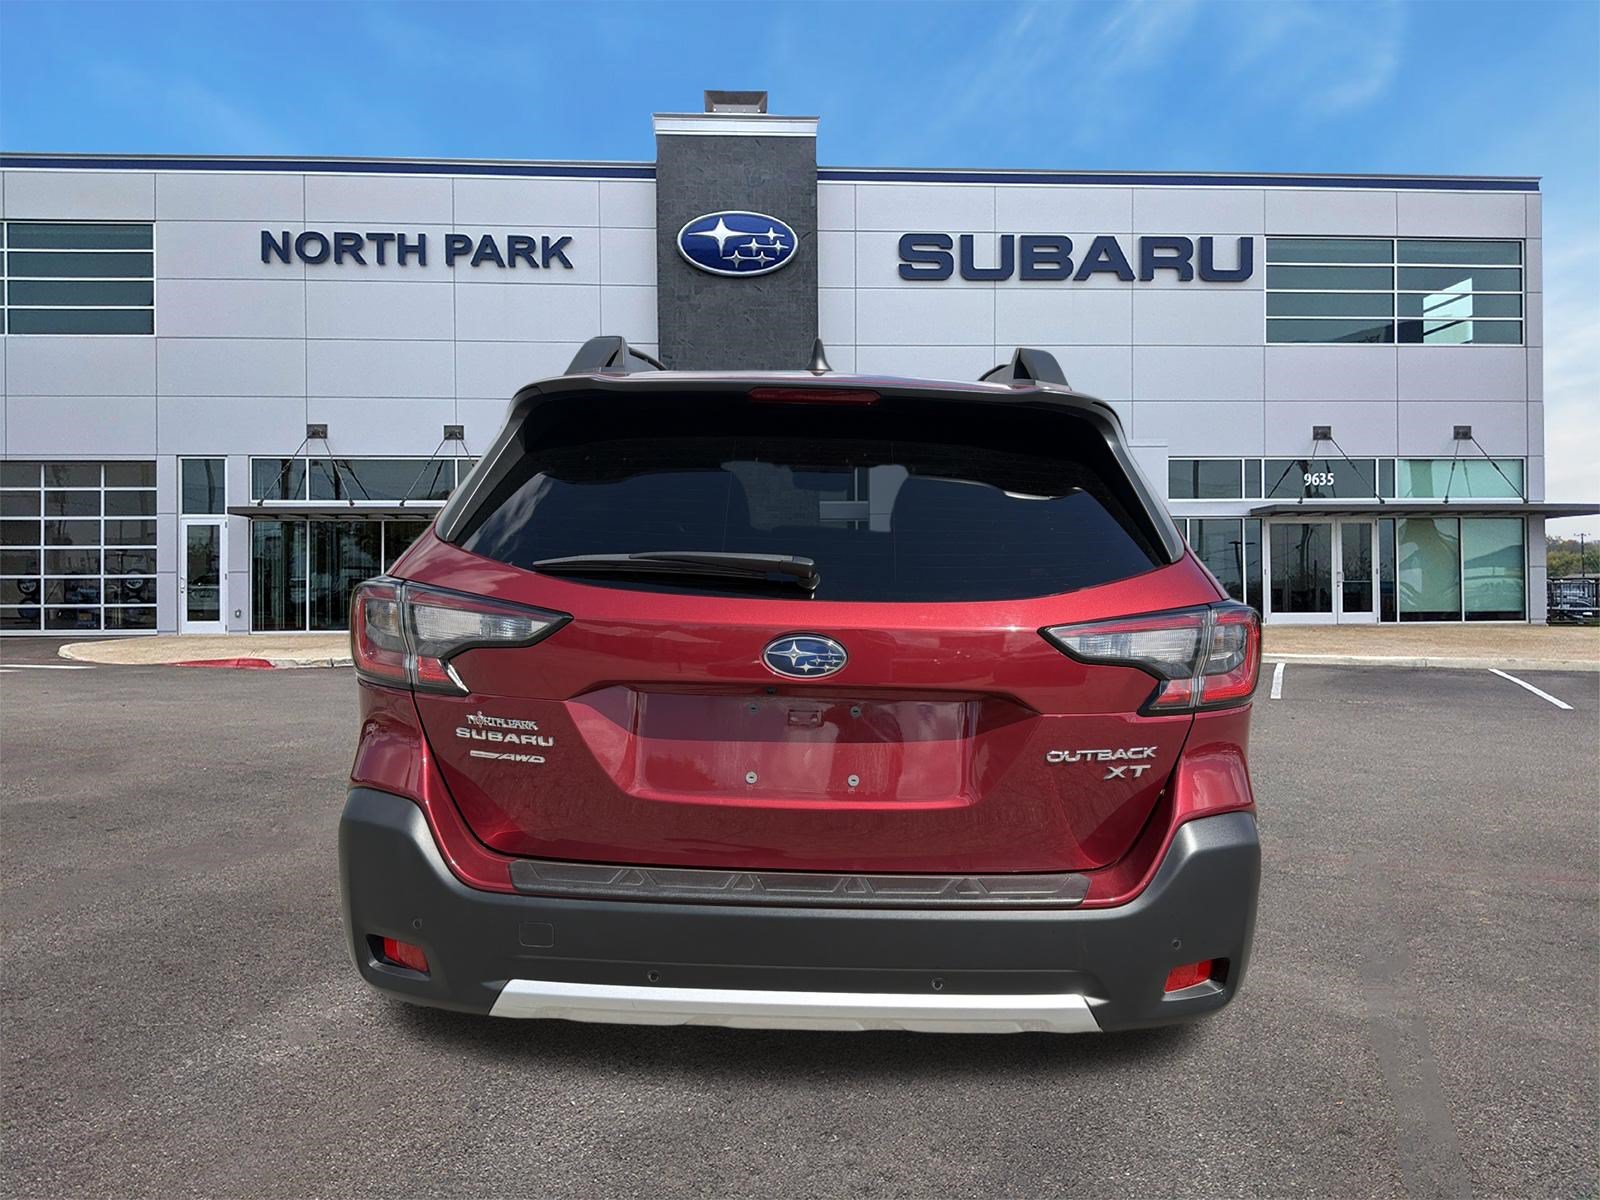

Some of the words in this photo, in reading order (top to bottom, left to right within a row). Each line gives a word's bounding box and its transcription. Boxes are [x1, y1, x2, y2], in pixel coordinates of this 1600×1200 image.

[261, 230, 427, 267] NORTH
[444, 233, 573, 269] PARK
[898, 233, 1254, 282] SUBARU
[1303, 472, 1335, 487] 9635
[456, 727, 554, 747] SUBARU
[498, 753, 546, 763] AWD
[1046, 746, 1158, 763] OUTBACK
[1104, 764, 1151, 780] XT
